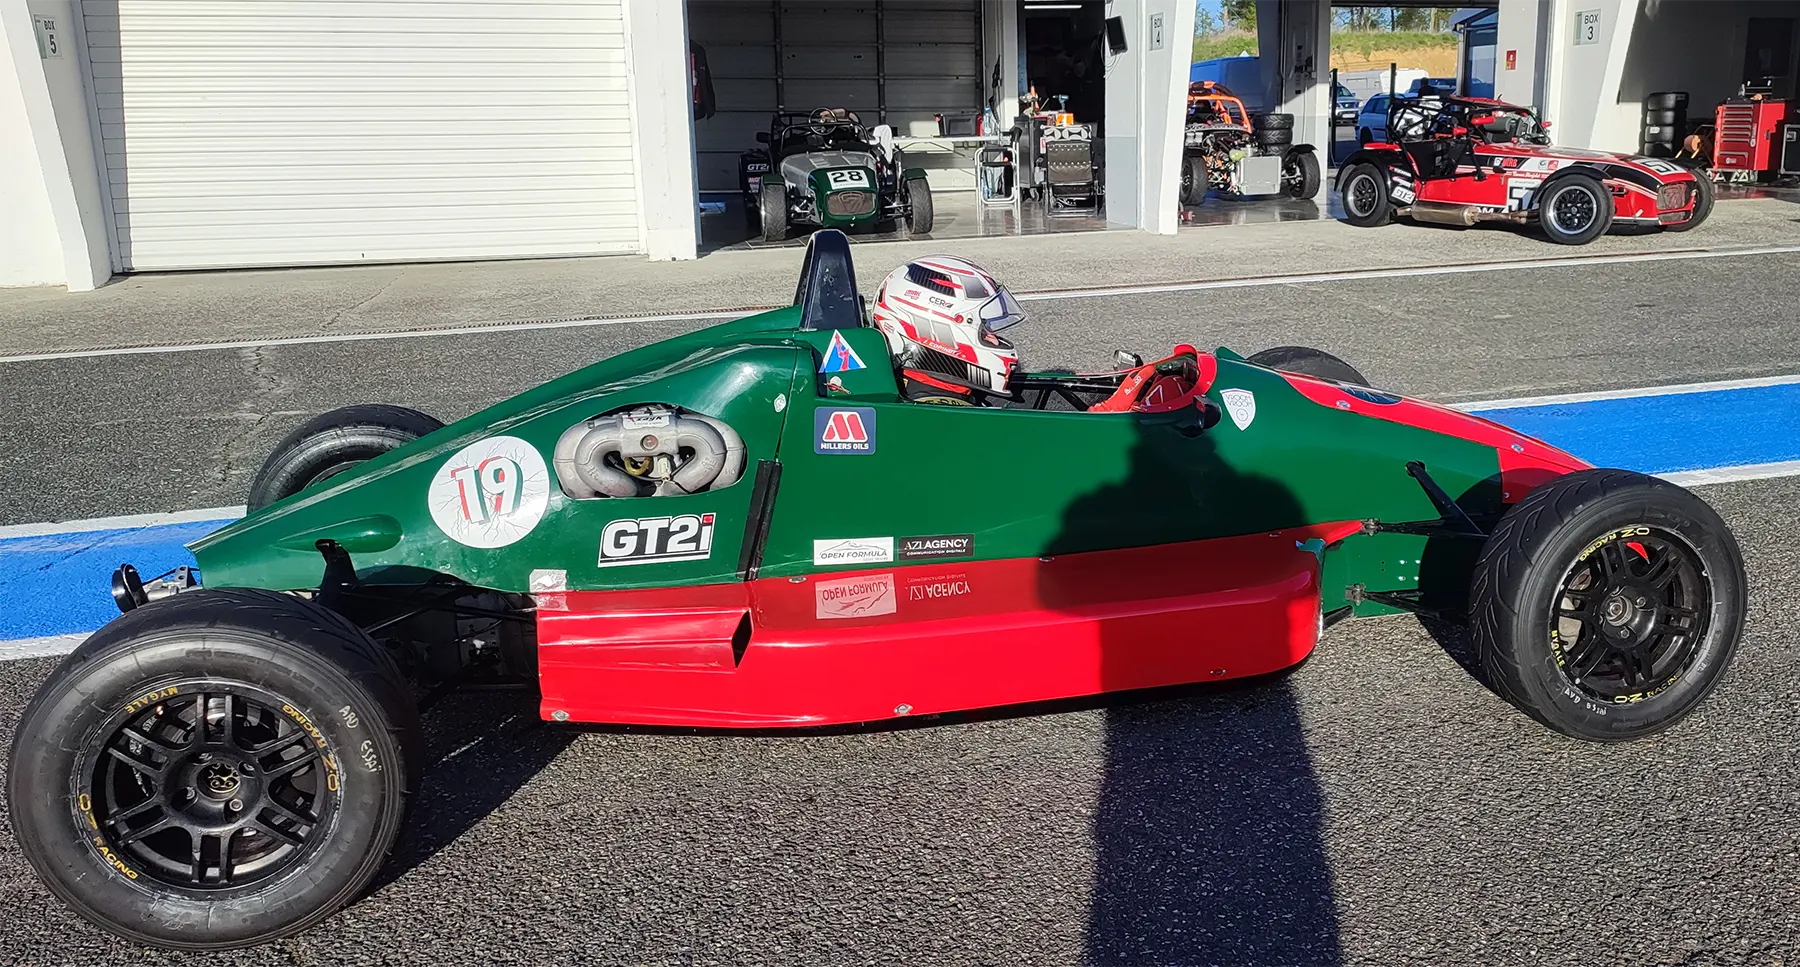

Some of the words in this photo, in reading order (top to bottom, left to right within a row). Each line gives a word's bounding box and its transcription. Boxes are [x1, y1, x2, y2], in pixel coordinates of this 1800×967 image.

[43, 20, 55, 30] BOX
[1584, 13, 1599, 24] BOX
[1156, 30, 1161, 46] 4
[1587, 26, 1594, 40] 3
[49, 33, 57, 54] 5
[830, 170, 863, 183] 28
[820, 442, 852, 450] MILLERS
[853, 442, 869, 450] OILS
[451, 456, 523, 525] 19
[602, 514, 716, 558] GT2i
[847, 545, 888, 558] FORMULA
[1579, 533, 1617, 562] RACING
[1551, 629, 1566, 667] MYGALE
[124, 686, 178, 714] MYGALE
[282, 704, 328, 749] RACING
